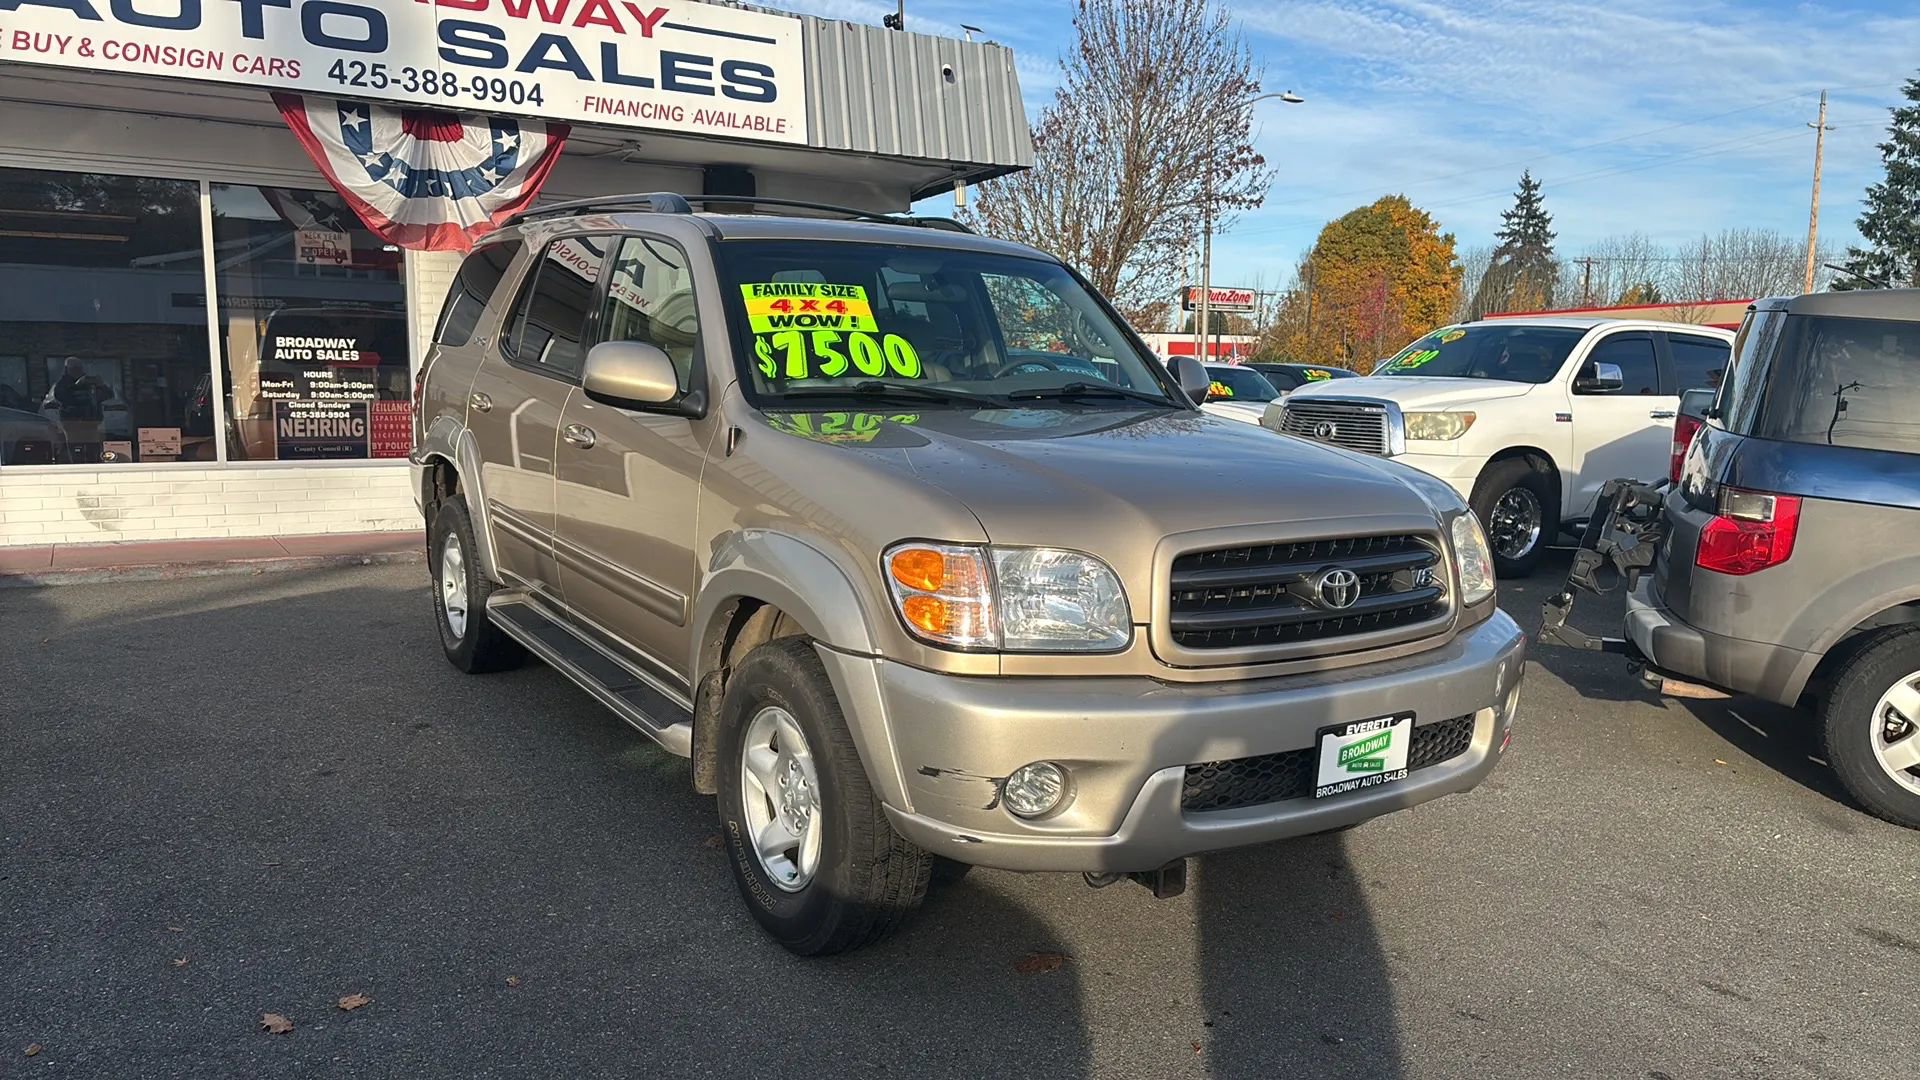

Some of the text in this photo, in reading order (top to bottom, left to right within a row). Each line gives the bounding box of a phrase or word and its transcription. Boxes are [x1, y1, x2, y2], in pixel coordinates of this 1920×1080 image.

[11, 29, 72, 55] BUY
[77, 37, 96, 58] &
[102, 39, 224, 72] CONSIGN
[232, 54, 301, 79] CARS
[437, 18, 777, 103] SALES
[328, 58, 544, 108] 425-388-9904
[583, 95, 786, 134] FINANCING AVAILABLE
[312, 248, 336, 257] OPEN
[752, 283, 859, 298] FAMILY SIZE
[276, 336, 356, 349] BROADWAY
[275, 349, 360, 361] AUTO SALES
[303, 371, 333, 379] HOURS
[261, 380, 294, 388] Mon-Fri
[262, 391, 300, 400] Saturday
[288, 401, 351, 410] Closed Sundays
[290, 411, 350, 419] 425-388-9904
[280, 418, 365, 438] NEHRING
[1345, 717, 1394, 736] EVERETT
[1341, 734, 1389, 761] BROADWAY
[1316, 768, 1408, 798] BROADWAY AUTO SALES
